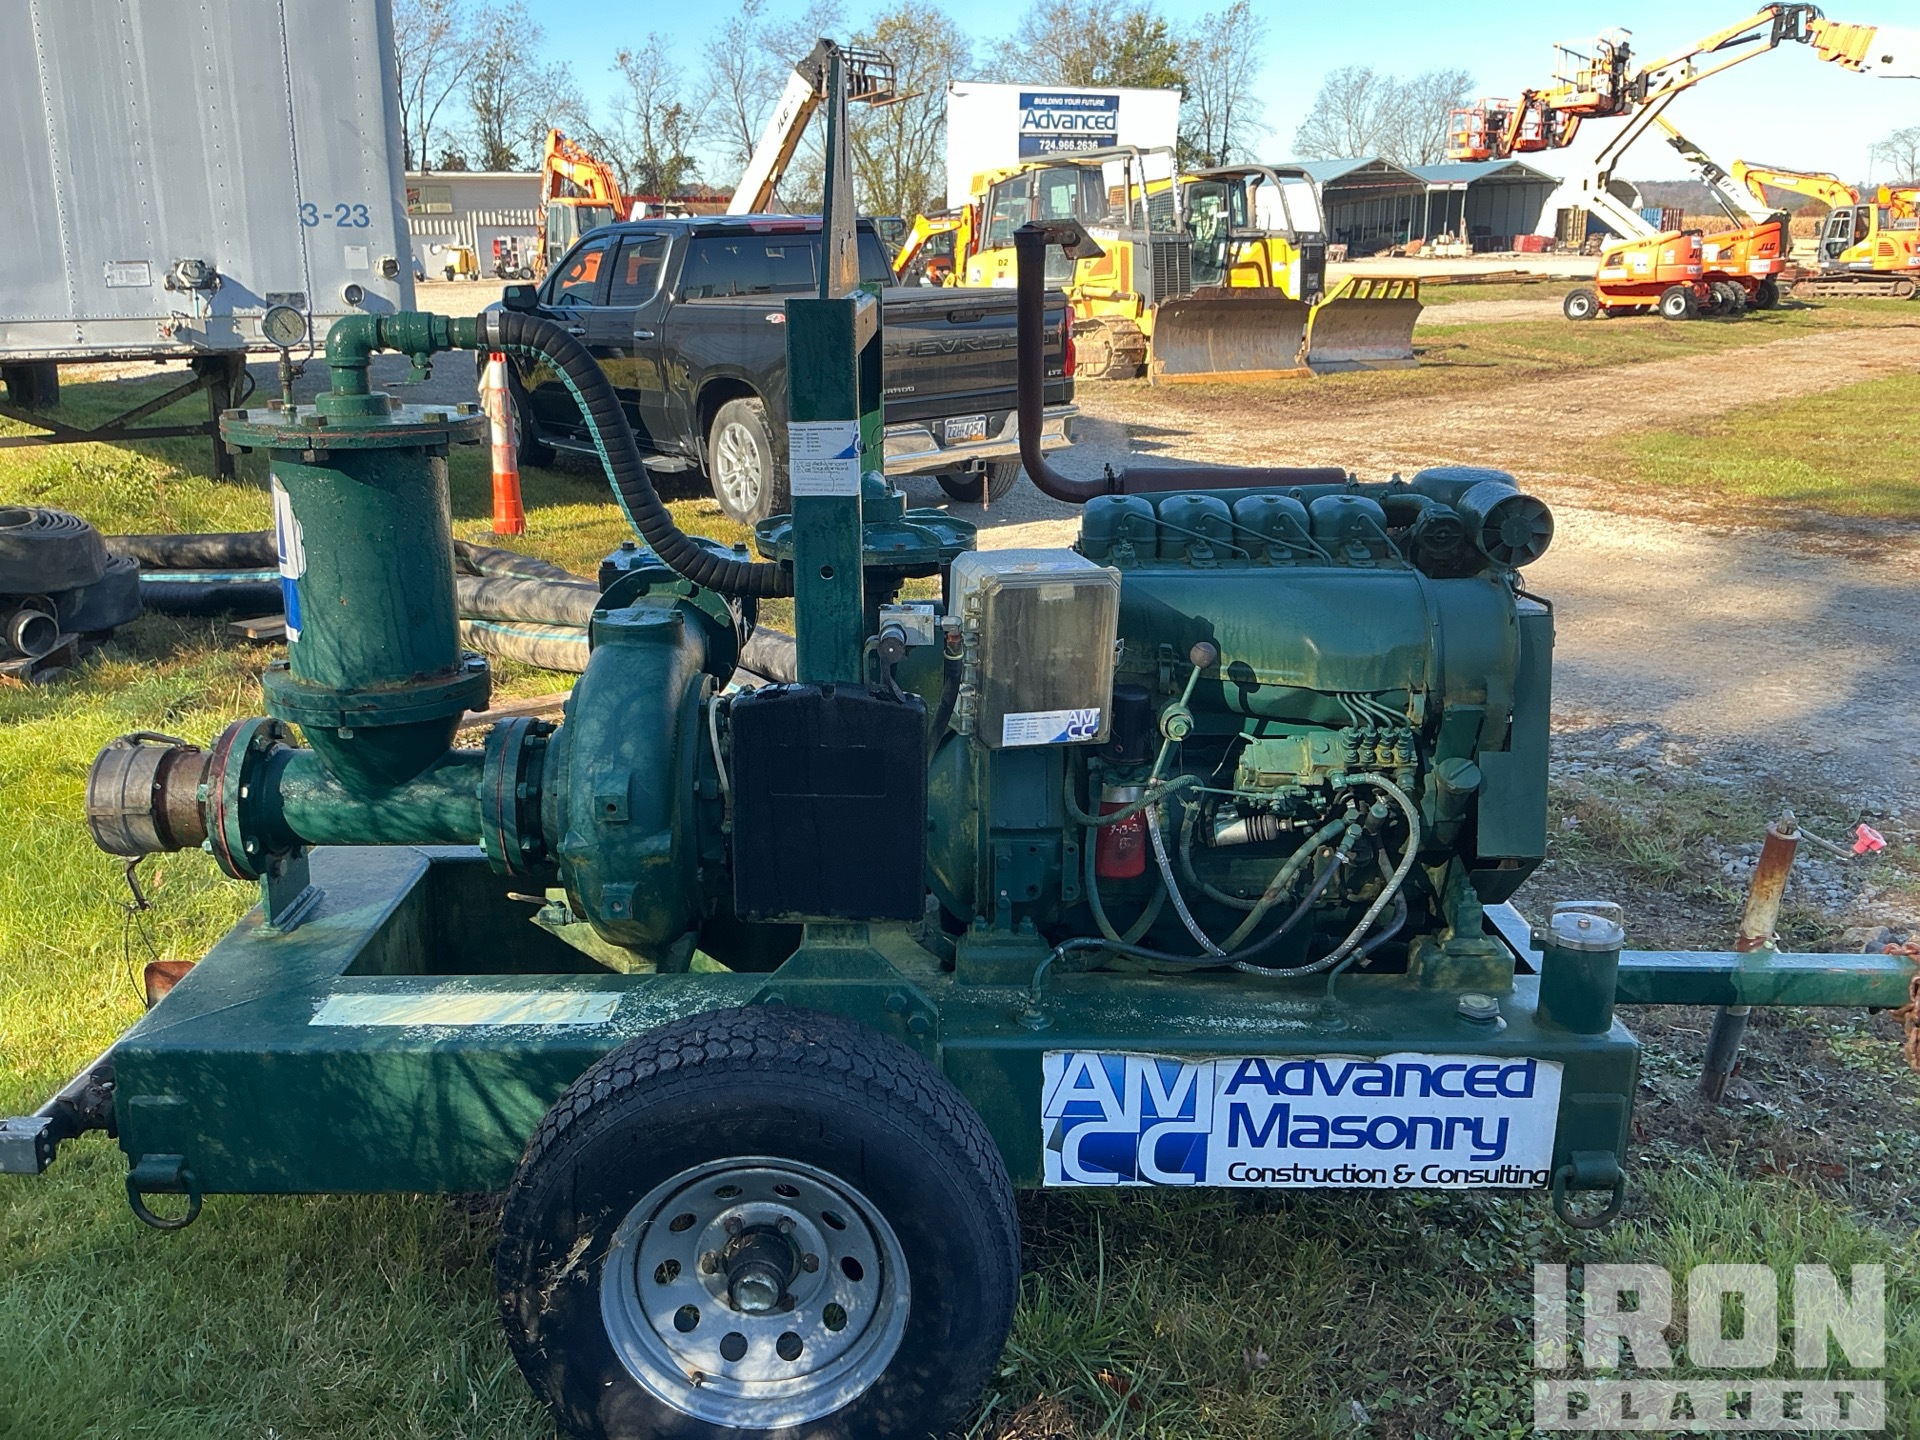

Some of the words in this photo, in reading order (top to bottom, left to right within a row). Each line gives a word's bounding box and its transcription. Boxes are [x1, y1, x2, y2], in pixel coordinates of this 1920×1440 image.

[1034, 97, 1063, 105] BUILDING
[1064, 98, 1081, 106] YOUR
[1082, 98, 1106, 107] FUTURE
[1021, 108, 1117, 130] Advanced
[1039, 139, 1099, 151] 724.966.2636
[302, 203, 371, 228] 3-23
[1758, 242, 1777, 252] JLG
[998, 259, 1008, 267] D2
[1224, 1057, 1537, 1098] Advanced
[1228, 1102, 1510, 1161] Masonry
[1228, 1162, 1386, 1183] Construction
[1393, 1163, 1415, 1184] &
[1420, 1164, 1550, 1188] Consulting
